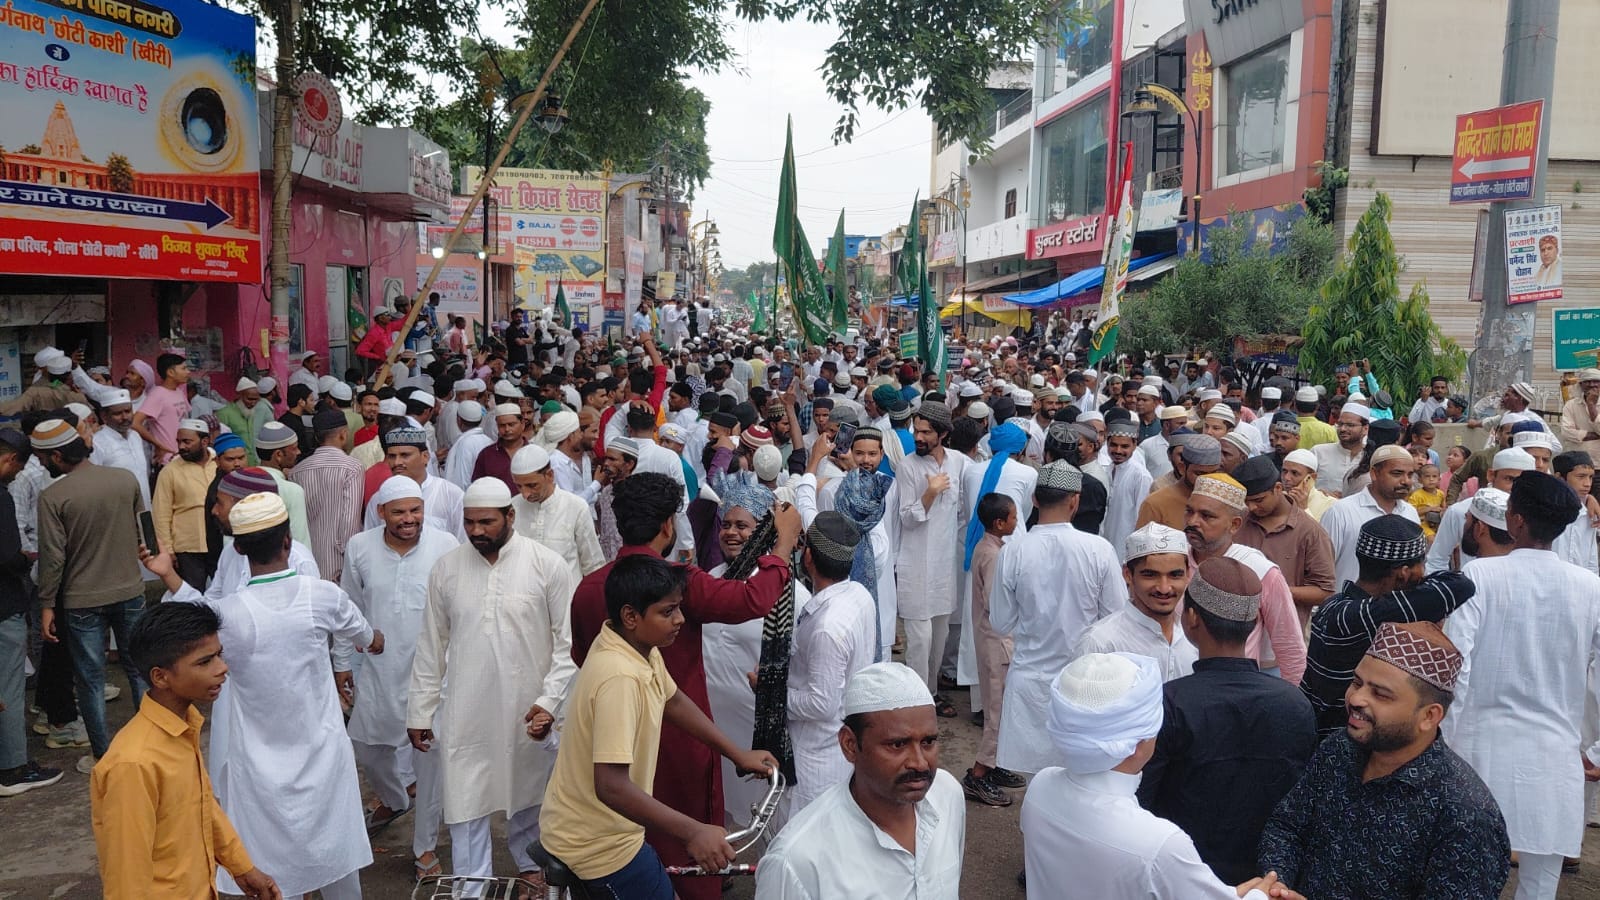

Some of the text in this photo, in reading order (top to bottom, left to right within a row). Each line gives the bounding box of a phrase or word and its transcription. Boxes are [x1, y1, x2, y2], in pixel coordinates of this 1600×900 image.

[88, 0, 132, 23] पावन
[134, 8, 175, 35] नगरी
[132, 39, 172, 69] (खीरी)
[24, 65, 80, 97] हार्दिक
[84, 79, 134, 106] स्वागत
[134, 83, 149, 114] है
[1457, 106, 1538, 158] मन्दिर जाने का मार्ग
[18, 188, 68, 205] जाने
[71, 194, 104, 209] का
[107, 198, 167, 215] रास्ता
[518, 181, 561, 208] किचन
[162, 235, 191, 255] विजय
[521, 236, 552, 247] USHA
[1034, 216, 1100, 257] सुन्दर स्टोर्स
